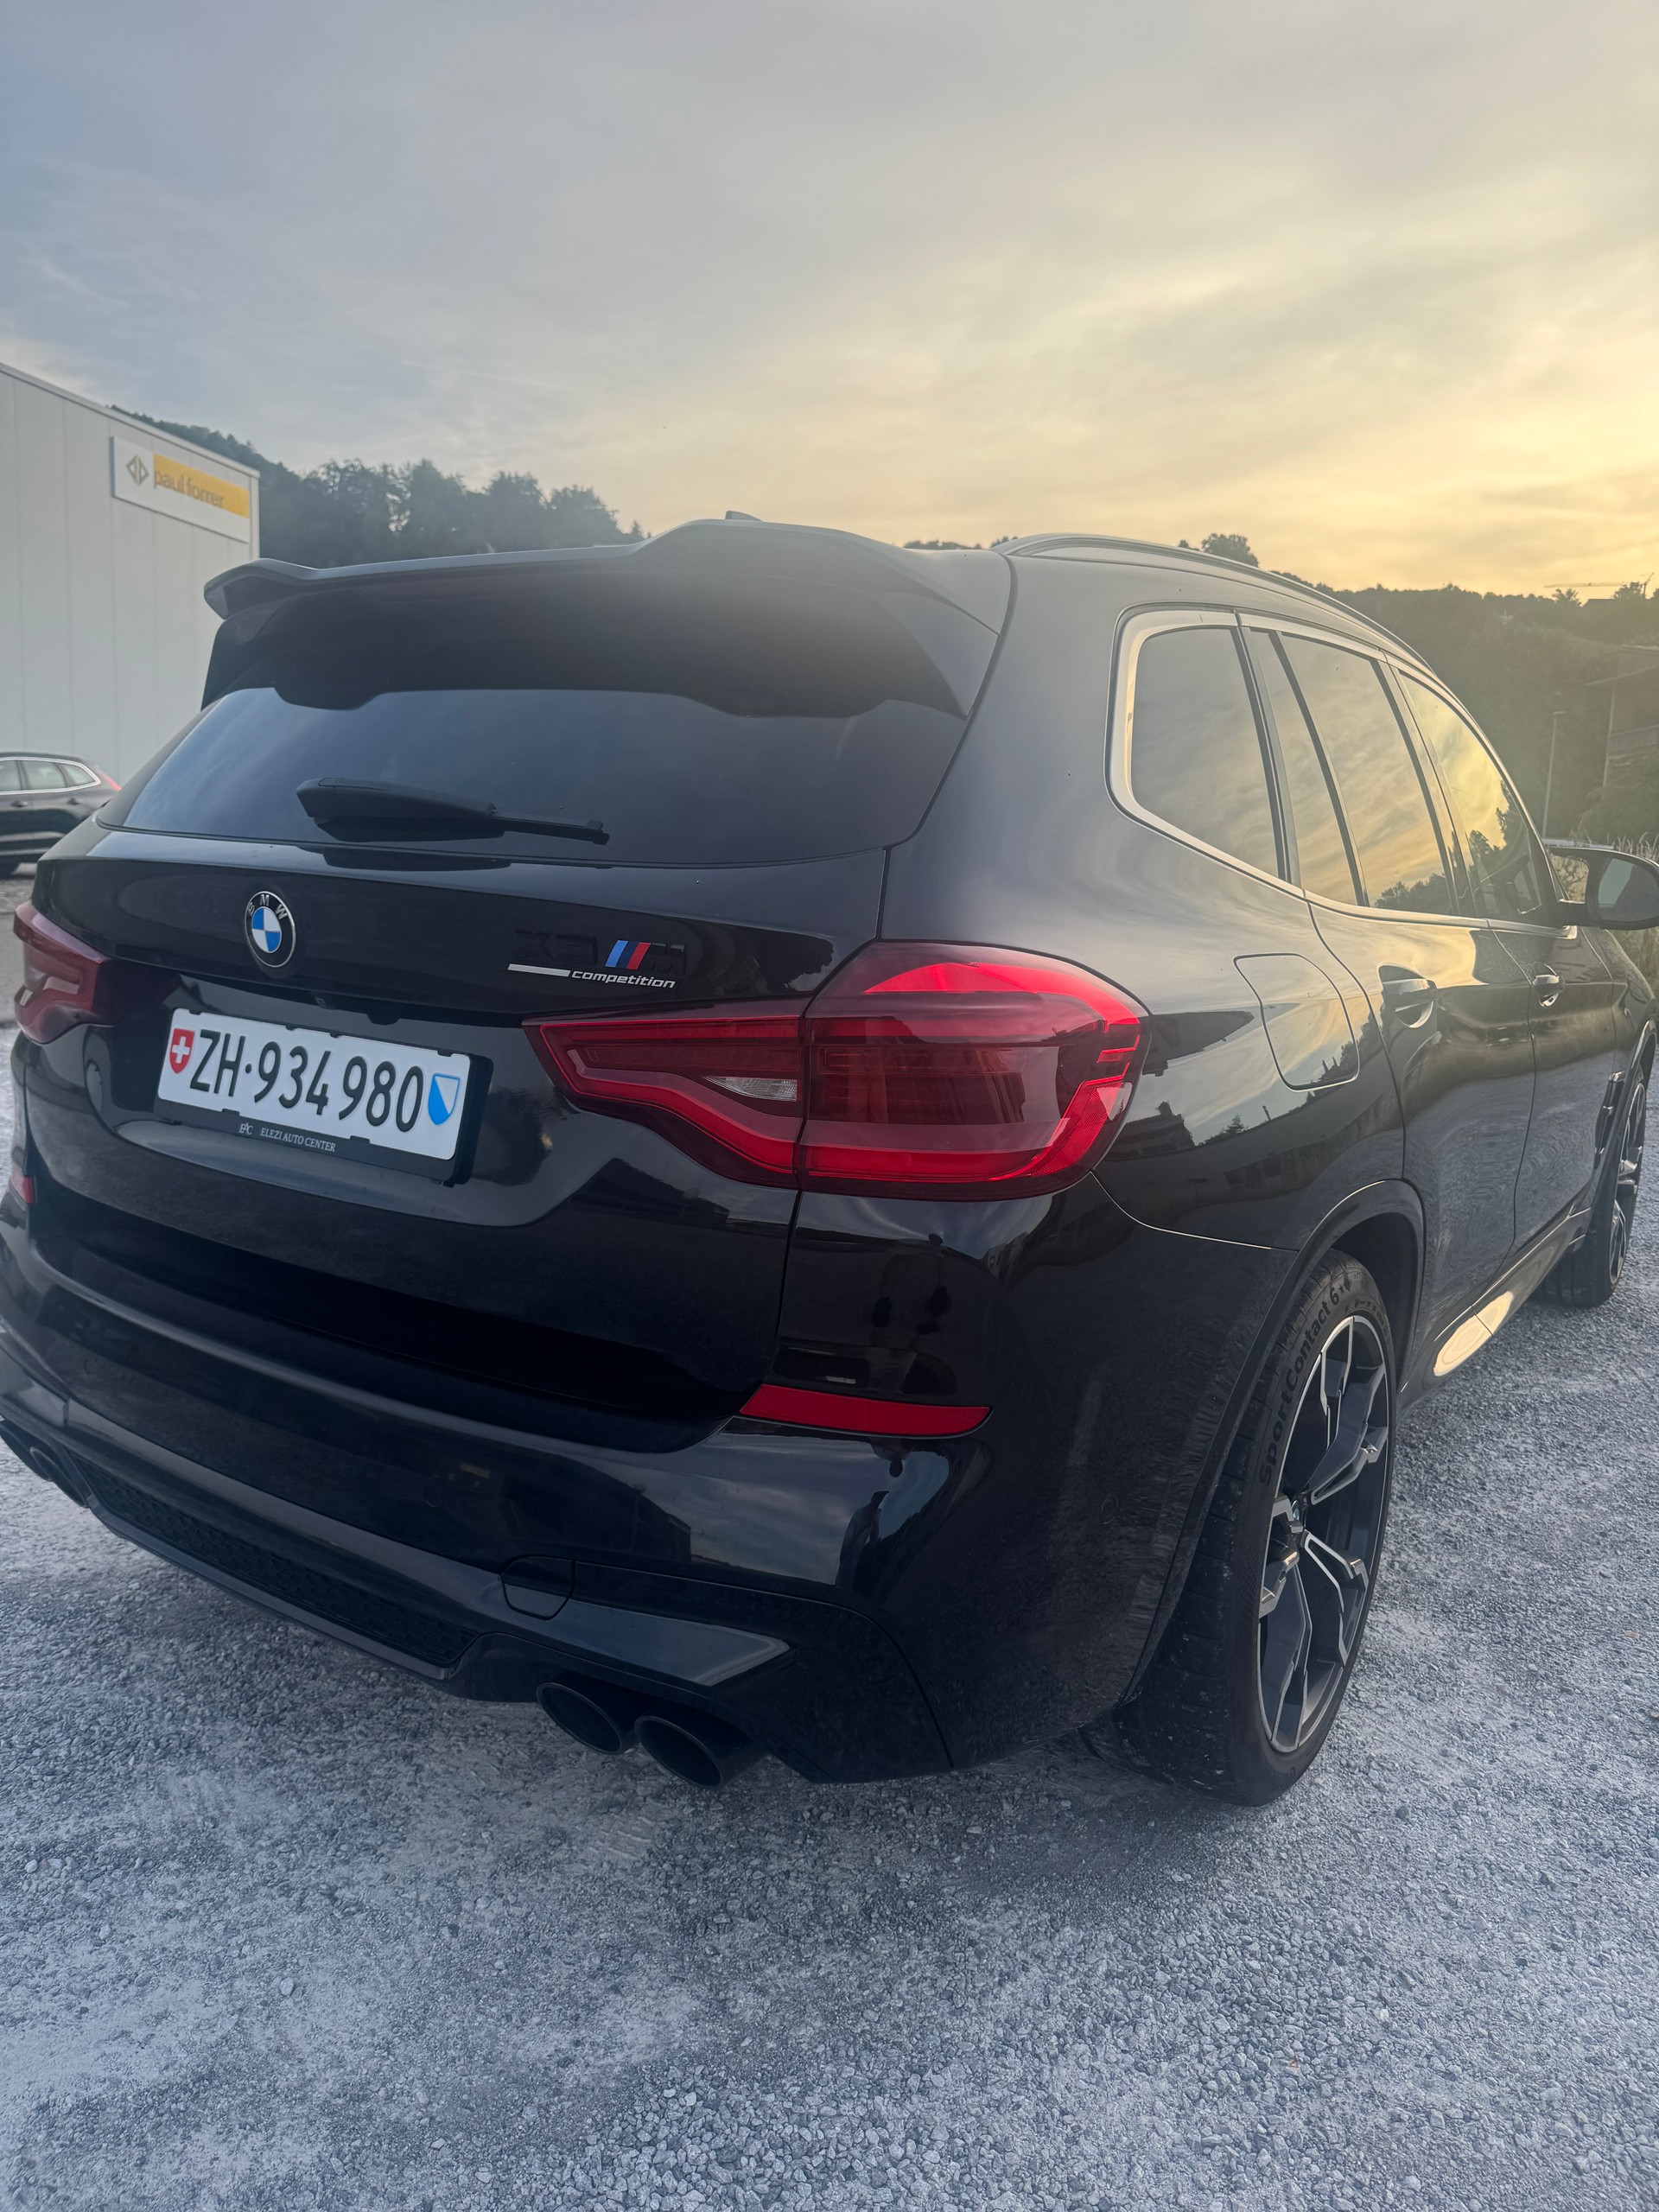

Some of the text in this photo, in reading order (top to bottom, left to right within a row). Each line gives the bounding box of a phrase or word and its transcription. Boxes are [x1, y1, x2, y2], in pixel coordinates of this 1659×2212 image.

[154, 470, 225, 507] paul forrer
[247, 893, 288, 919] BMW
[571, 969, 676, 988] competition
[261, 1128, 283, 1141] ELEZI
[283, 1132, 304, 1145] AUTO
[305, 1137, 336, 1153] CENTER
[1258, 1286, 1340, 1486] SportContact 6
